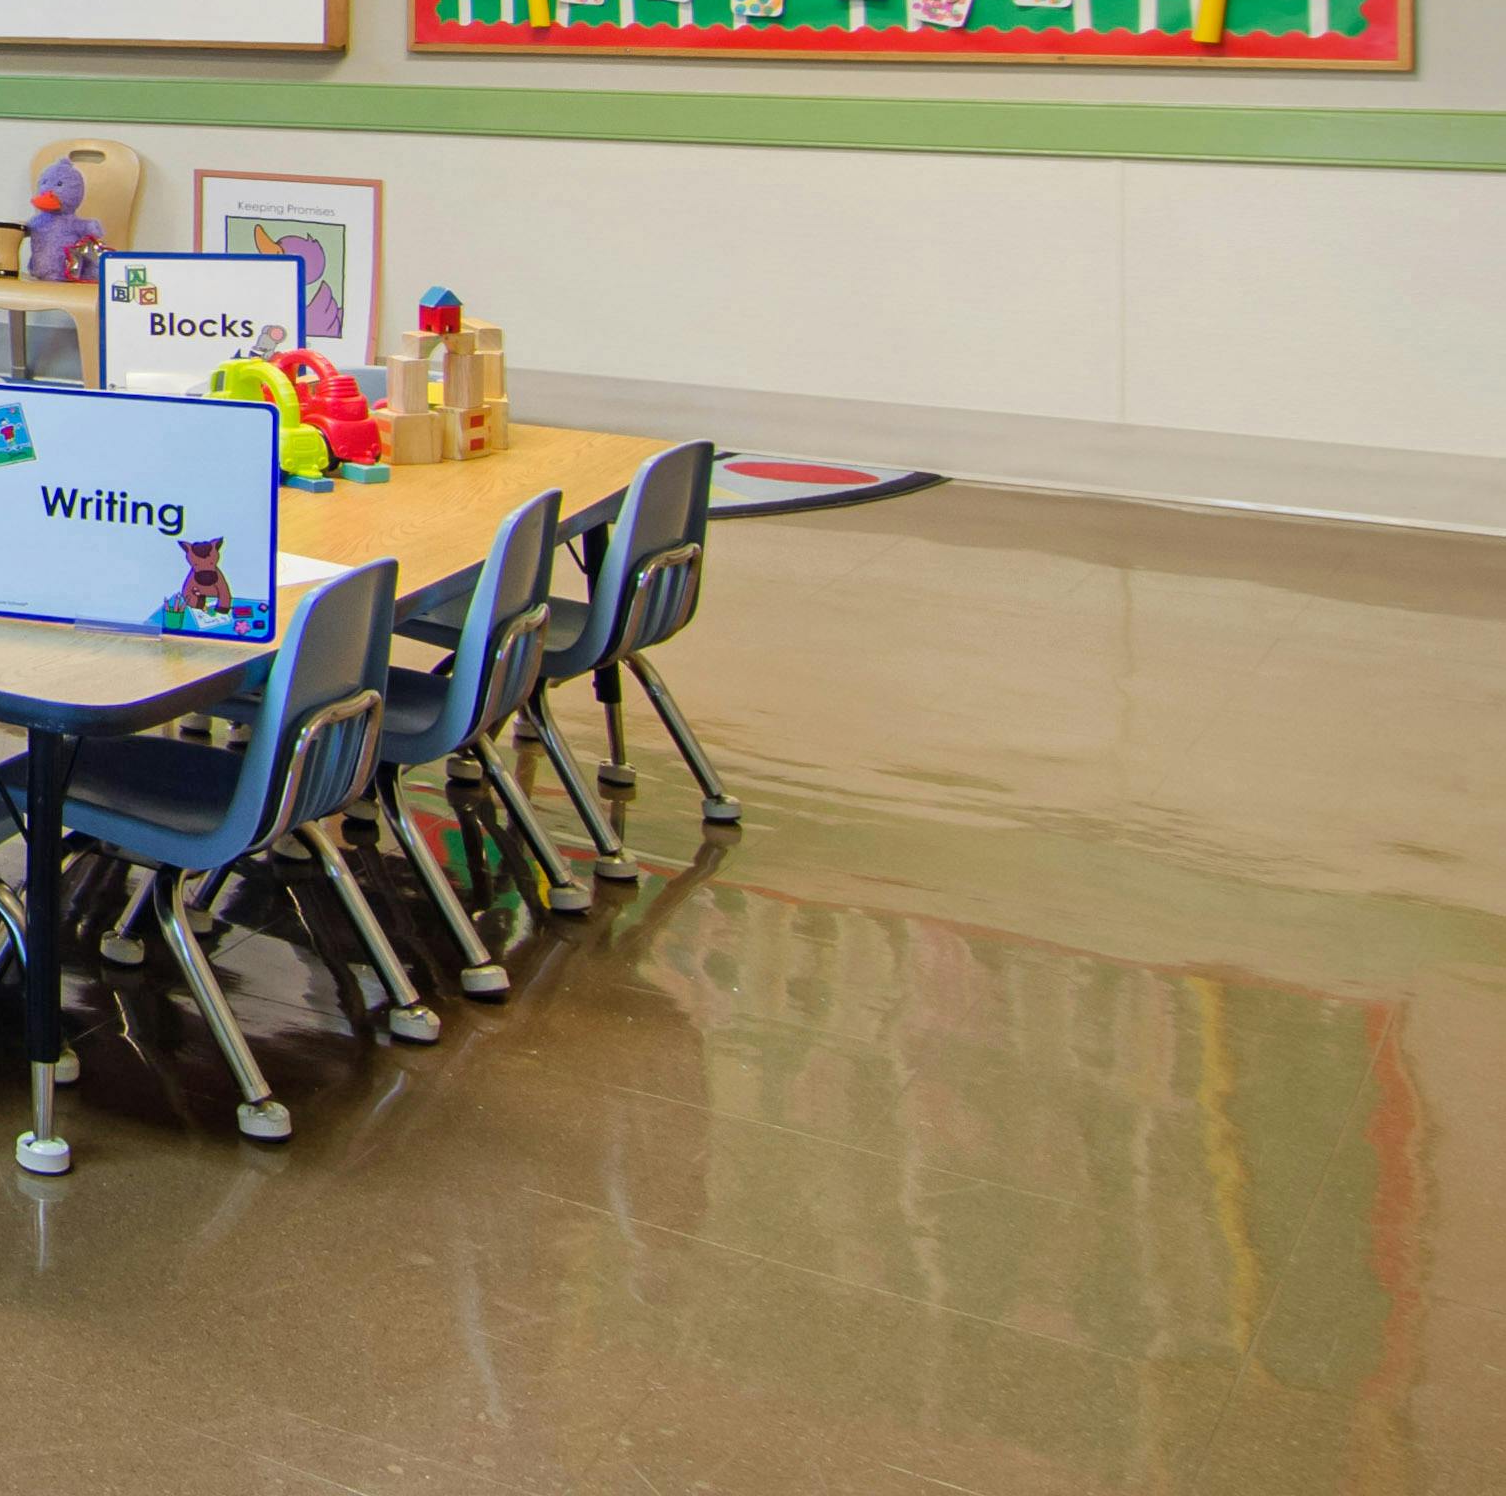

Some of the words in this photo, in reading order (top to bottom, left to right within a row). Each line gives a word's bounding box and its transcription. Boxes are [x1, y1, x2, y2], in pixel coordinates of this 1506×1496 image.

[237, 200, 284, 215] Keeping
[287, 203, 336, 217] Promises
[131, 270, 145, 283] A
[115, 287, 128, 301] B
[143, 289, 155, 303] C
[149, 312, 254, 338] Blocks
[41, 485, 184, 536] Writing
